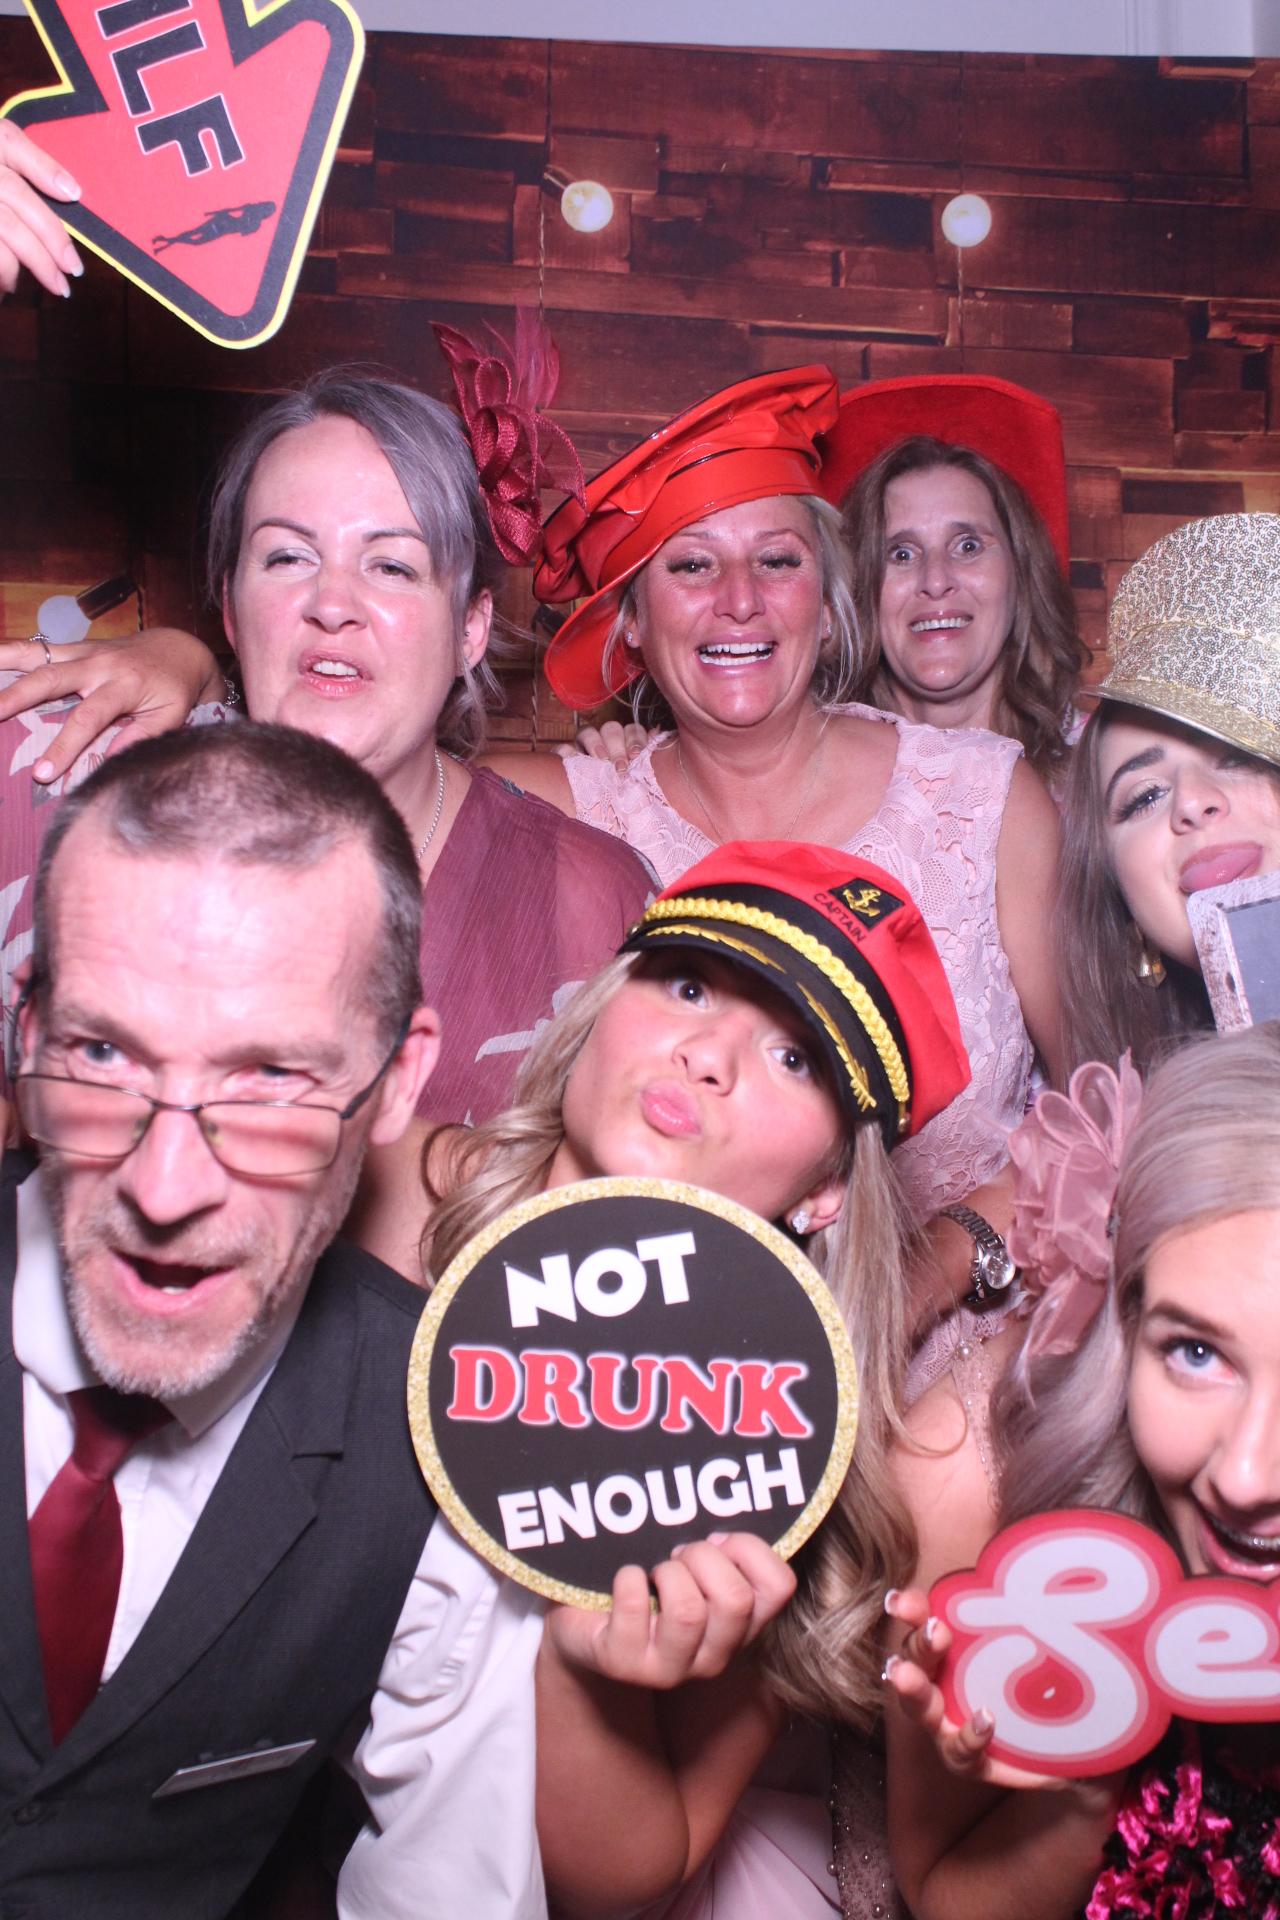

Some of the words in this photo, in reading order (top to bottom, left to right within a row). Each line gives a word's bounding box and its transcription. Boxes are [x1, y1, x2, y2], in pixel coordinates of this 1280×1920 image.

[96, 0, 245, 177] ILF
[813, 892, 866, 942] CAPTAIN
[504, 1231, 697, 1328] NOT
[446, 1345, 814, 1440] DRUNK
[497, 1447, 806, 1551] ENOUGH
[955, 1535, 1280, 1756] Se
